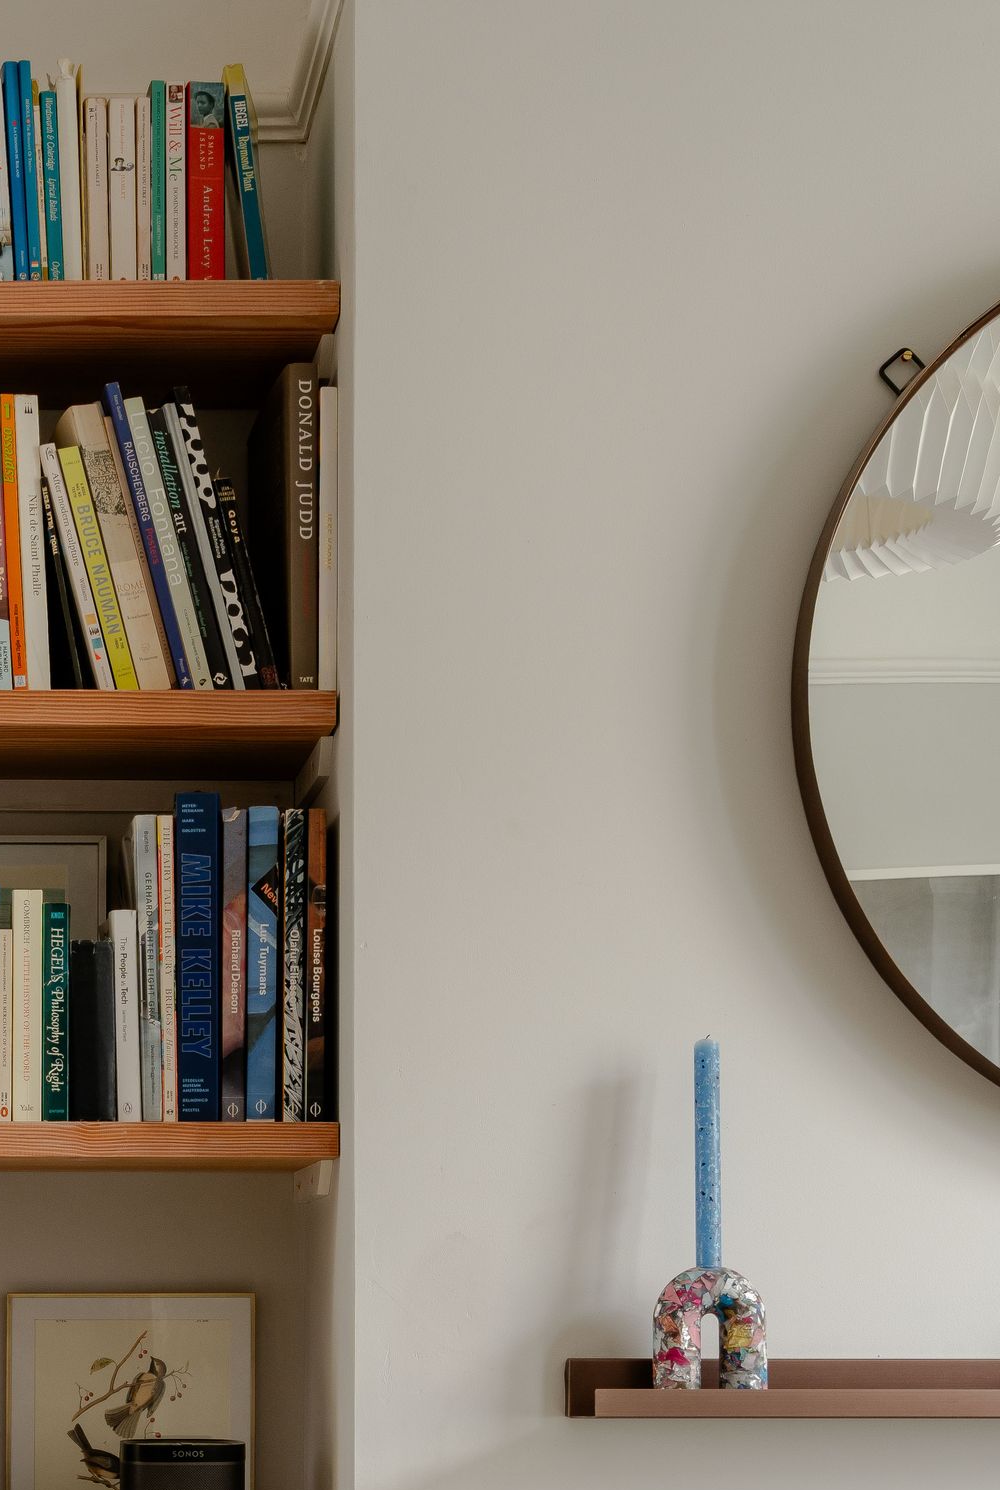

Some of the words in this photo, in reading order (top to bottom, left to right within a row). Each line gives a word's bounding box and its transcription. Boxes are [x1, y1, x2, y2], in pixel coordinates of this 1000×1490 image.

[168, 106, 182, 136] Will
[234, 100, 248, 130] HEGEL
[168, 140, 182, 153] &
[238, 136, 252, 170] Raymond
[168, 156, 182, 181] Me
[242, 171, 255, 192] Plant
[203, 185, 212, 232] Andrea
[201, 239, 212, 268] Levy
[298, 379, 313, 471] DONALD
[123, 441, 150, 522] RAUSCHENBERG
[129, 412, 156, 477] Lucio
[148, 488, 183, 587] Fontana
[155, 430, 183, 508] installation
[172, 512, 187, 534] art
[28, 495, 39, 516] Niki
[295, 481, 313, 540] JUDD
[29, 519, 39, 531] de
[30, 534, 40, 562] Saint
[31, 564, 41, 596] Phalle
[75, 504, 103, 558] BRUCE
[92, 564, 120, 635] NAUMAN
[144, 872, 153, 917] GERHARD
[180, 853, 212, 937] MIKE
[146, 920, 154, 960] RICHTER
[231, 929, 241, 970] Richard
[259, 923, 268, 943] Luc
[312, 929, 322, 965] Louise
[50, 927, 64, 983] HEGEL'S
[257, 946, 269, 995] Tuymans
[146, 968, 155, 997] EIGHT
[231, 973, 241, 1013] Deacon
[310, 967, 322, 1022] Bourgeois
[46, 986, 65, 1044] Philosophy
[148, 1001, 156, 1026] GRAY
[180, 948, 212, 1058] KELLEY
[50, 1047, 65, 1058] of
[46, 1058, 64, 1092] Right
[172, 1450, 204, 1458] SONOS
